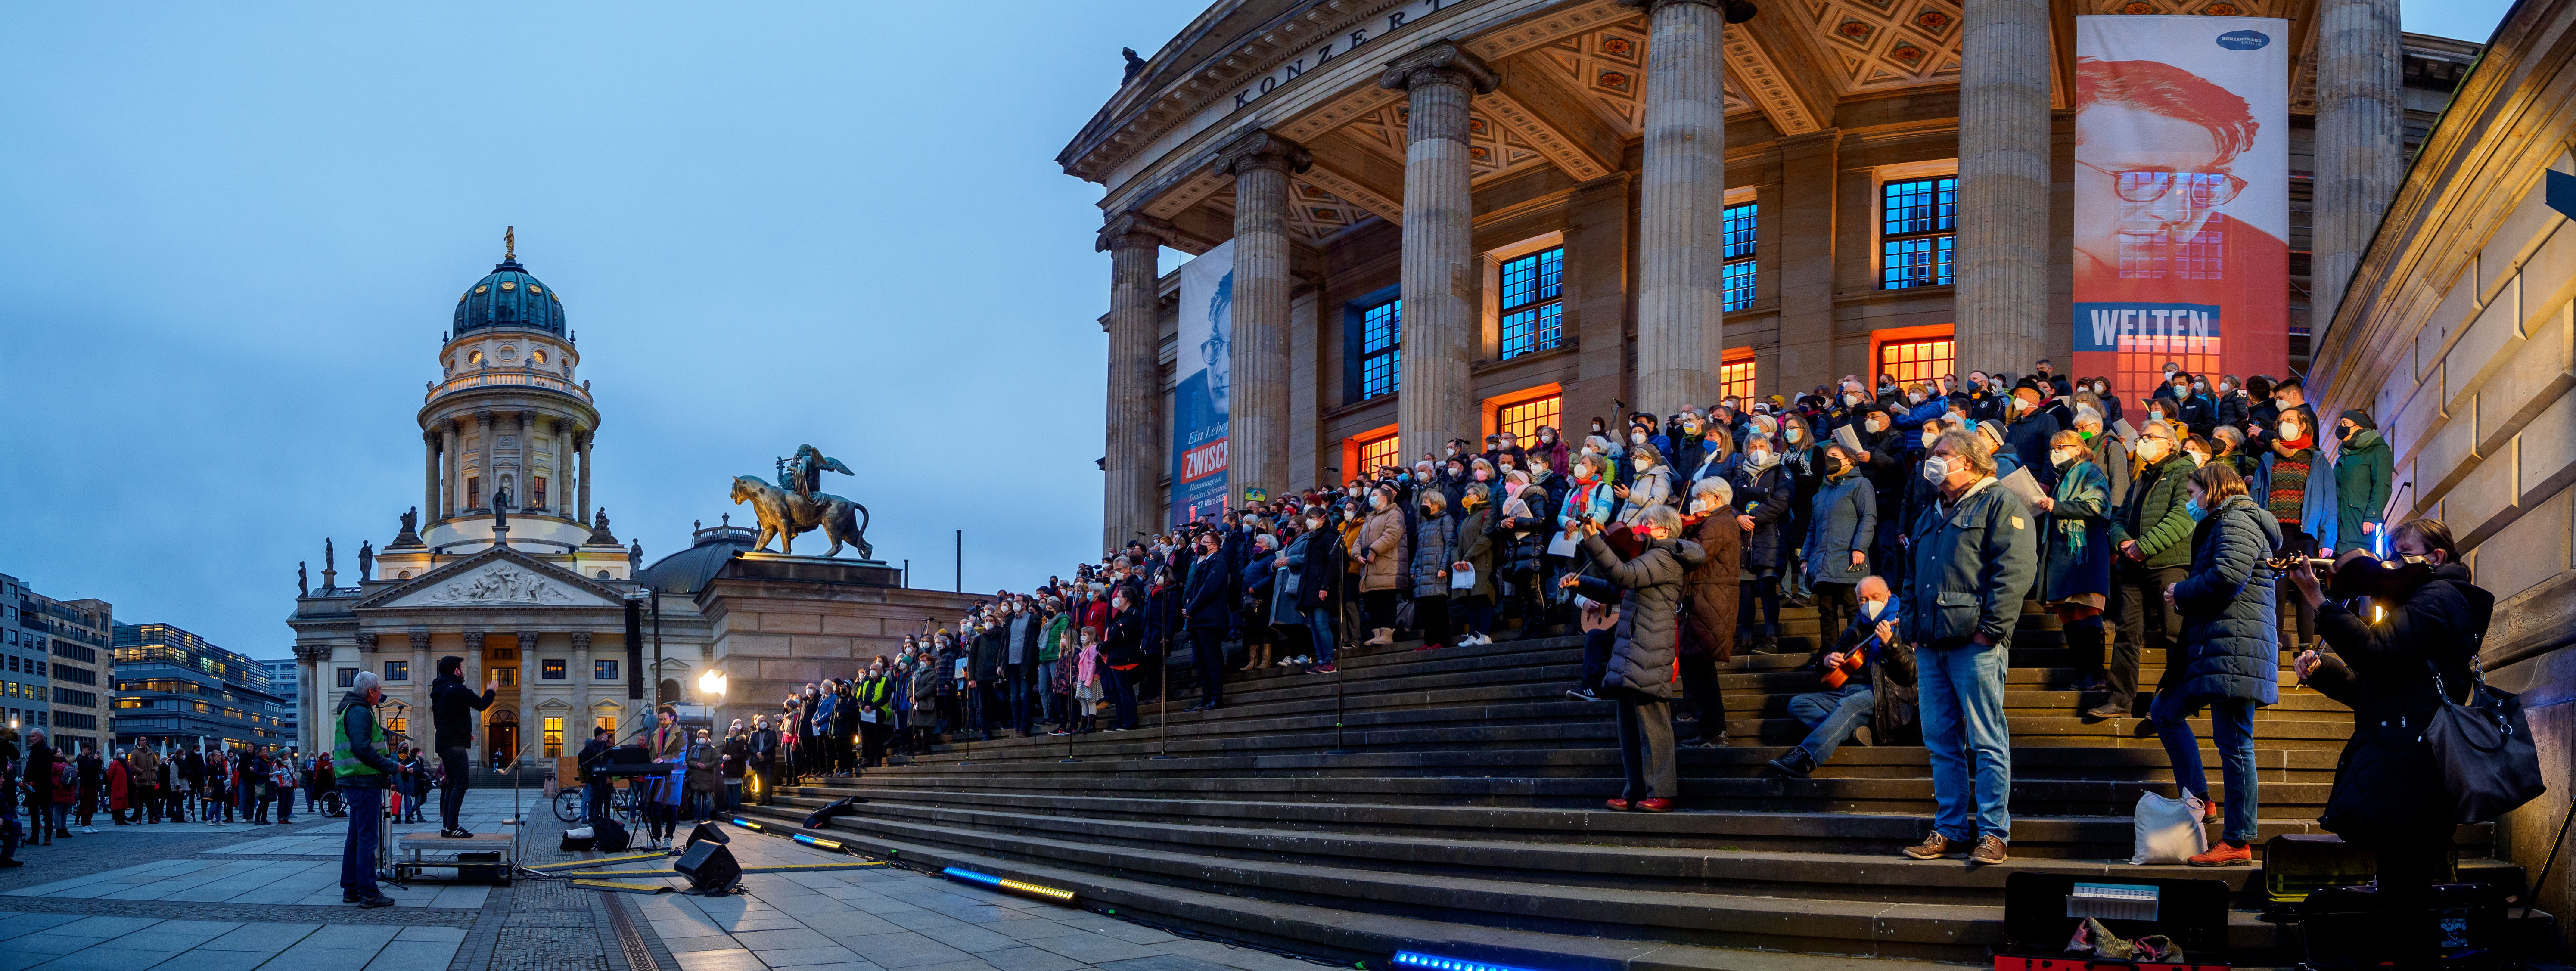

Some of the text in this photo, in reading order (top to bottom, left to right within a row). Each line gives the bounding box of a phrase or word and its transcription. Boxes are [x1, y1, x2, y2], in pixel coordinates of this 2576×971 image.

[2091, 309, 2209, 347] WELTEN
[1187, 431, 1203, 445] Ein
[1190, 479, 1215, 491] Hommage
[1189, 490, 1206, 502] Dmitri
[1204, 498, 1215, 507] März
[1215, 492, 1227, 503] 2022
